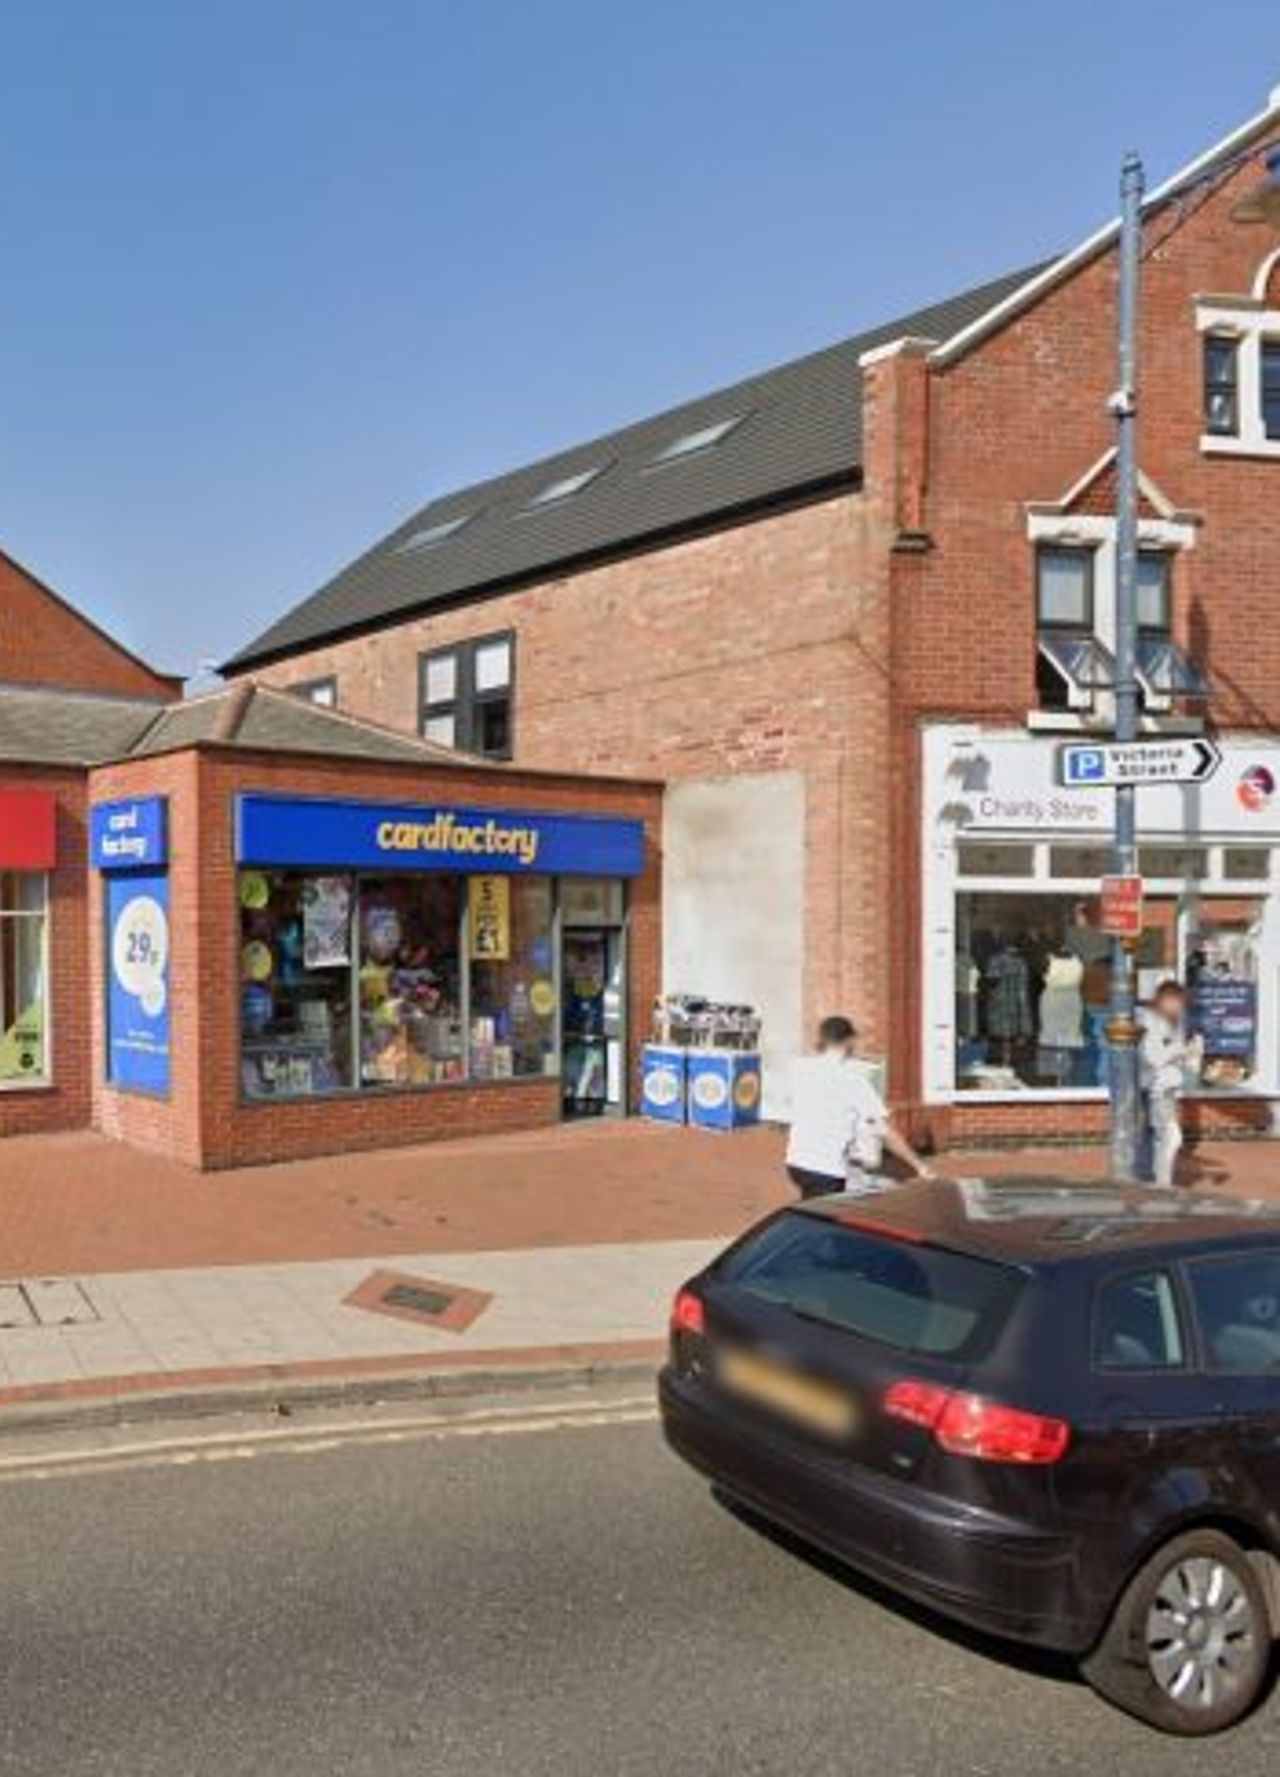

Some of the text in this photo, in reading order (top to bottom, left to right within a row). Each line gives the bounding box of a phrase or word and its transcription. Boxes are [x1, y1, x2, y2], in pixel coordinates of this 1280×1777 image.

[1078, 754, 1099, 777] P
[1112, 747, 1184, 762] Victoria
[1117, 763, 1179, 777] Street
[109, 804, 138, 833] card
[980, 797, 1099, 823] Charity Store
[101, 832, 148, 860] factory
[376, 811, 539, 865] cardfactory
